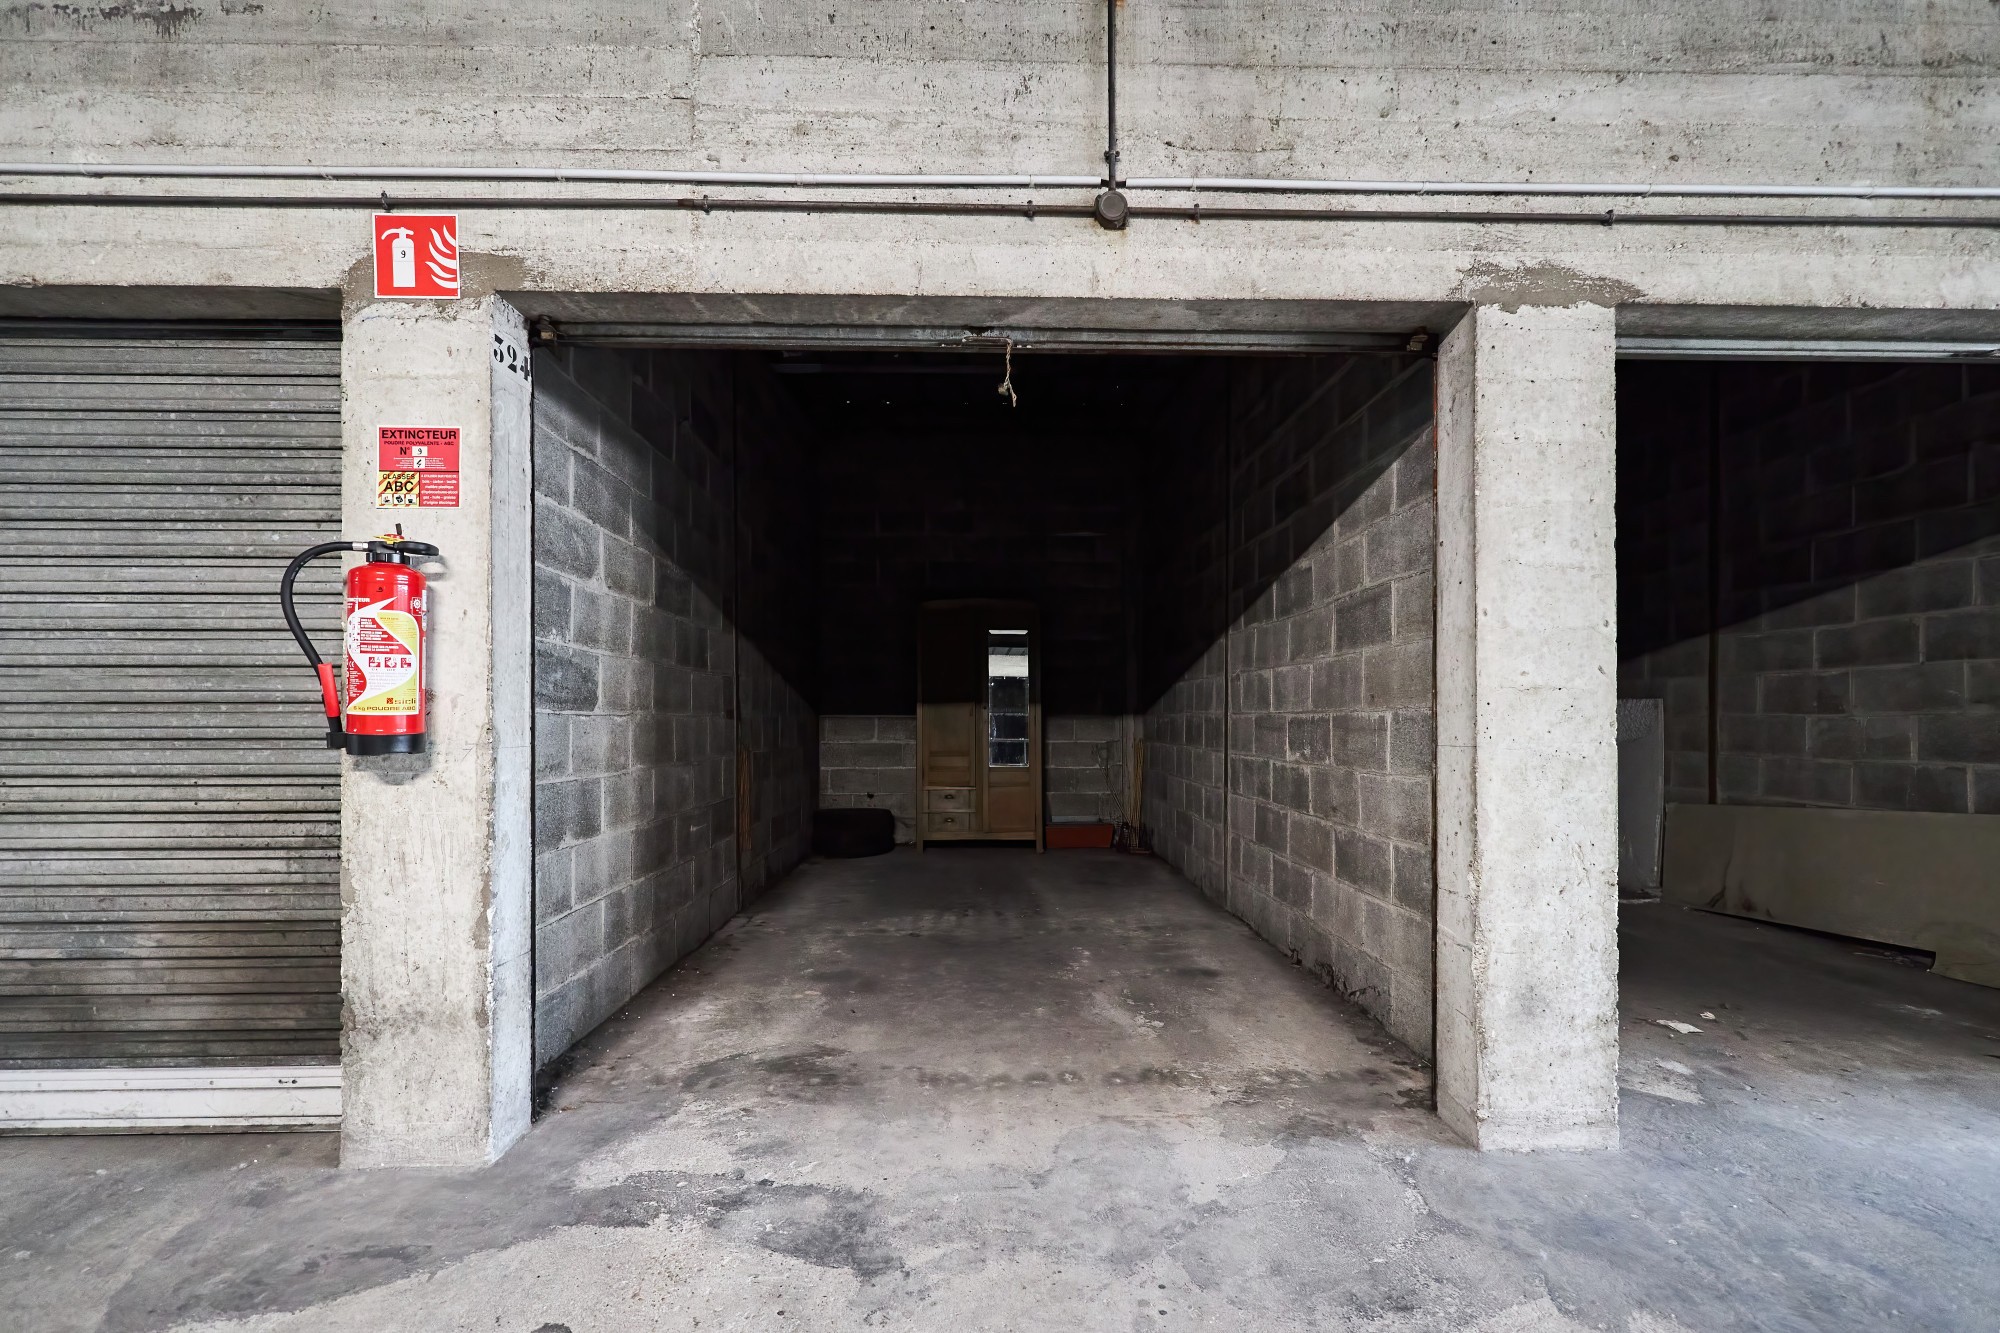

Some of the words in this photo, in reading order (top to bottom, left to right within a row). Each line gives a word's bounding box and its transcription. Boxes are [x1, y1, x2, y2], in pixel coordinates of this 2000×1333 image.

[400, 250, 406, 258] 9
[494, 333, 530, 382] 324
[382, 430, 456, 439] EXTINCTEUR
[400, 446, 410, 455] N°
[384, 481, 414, 492] ABC
